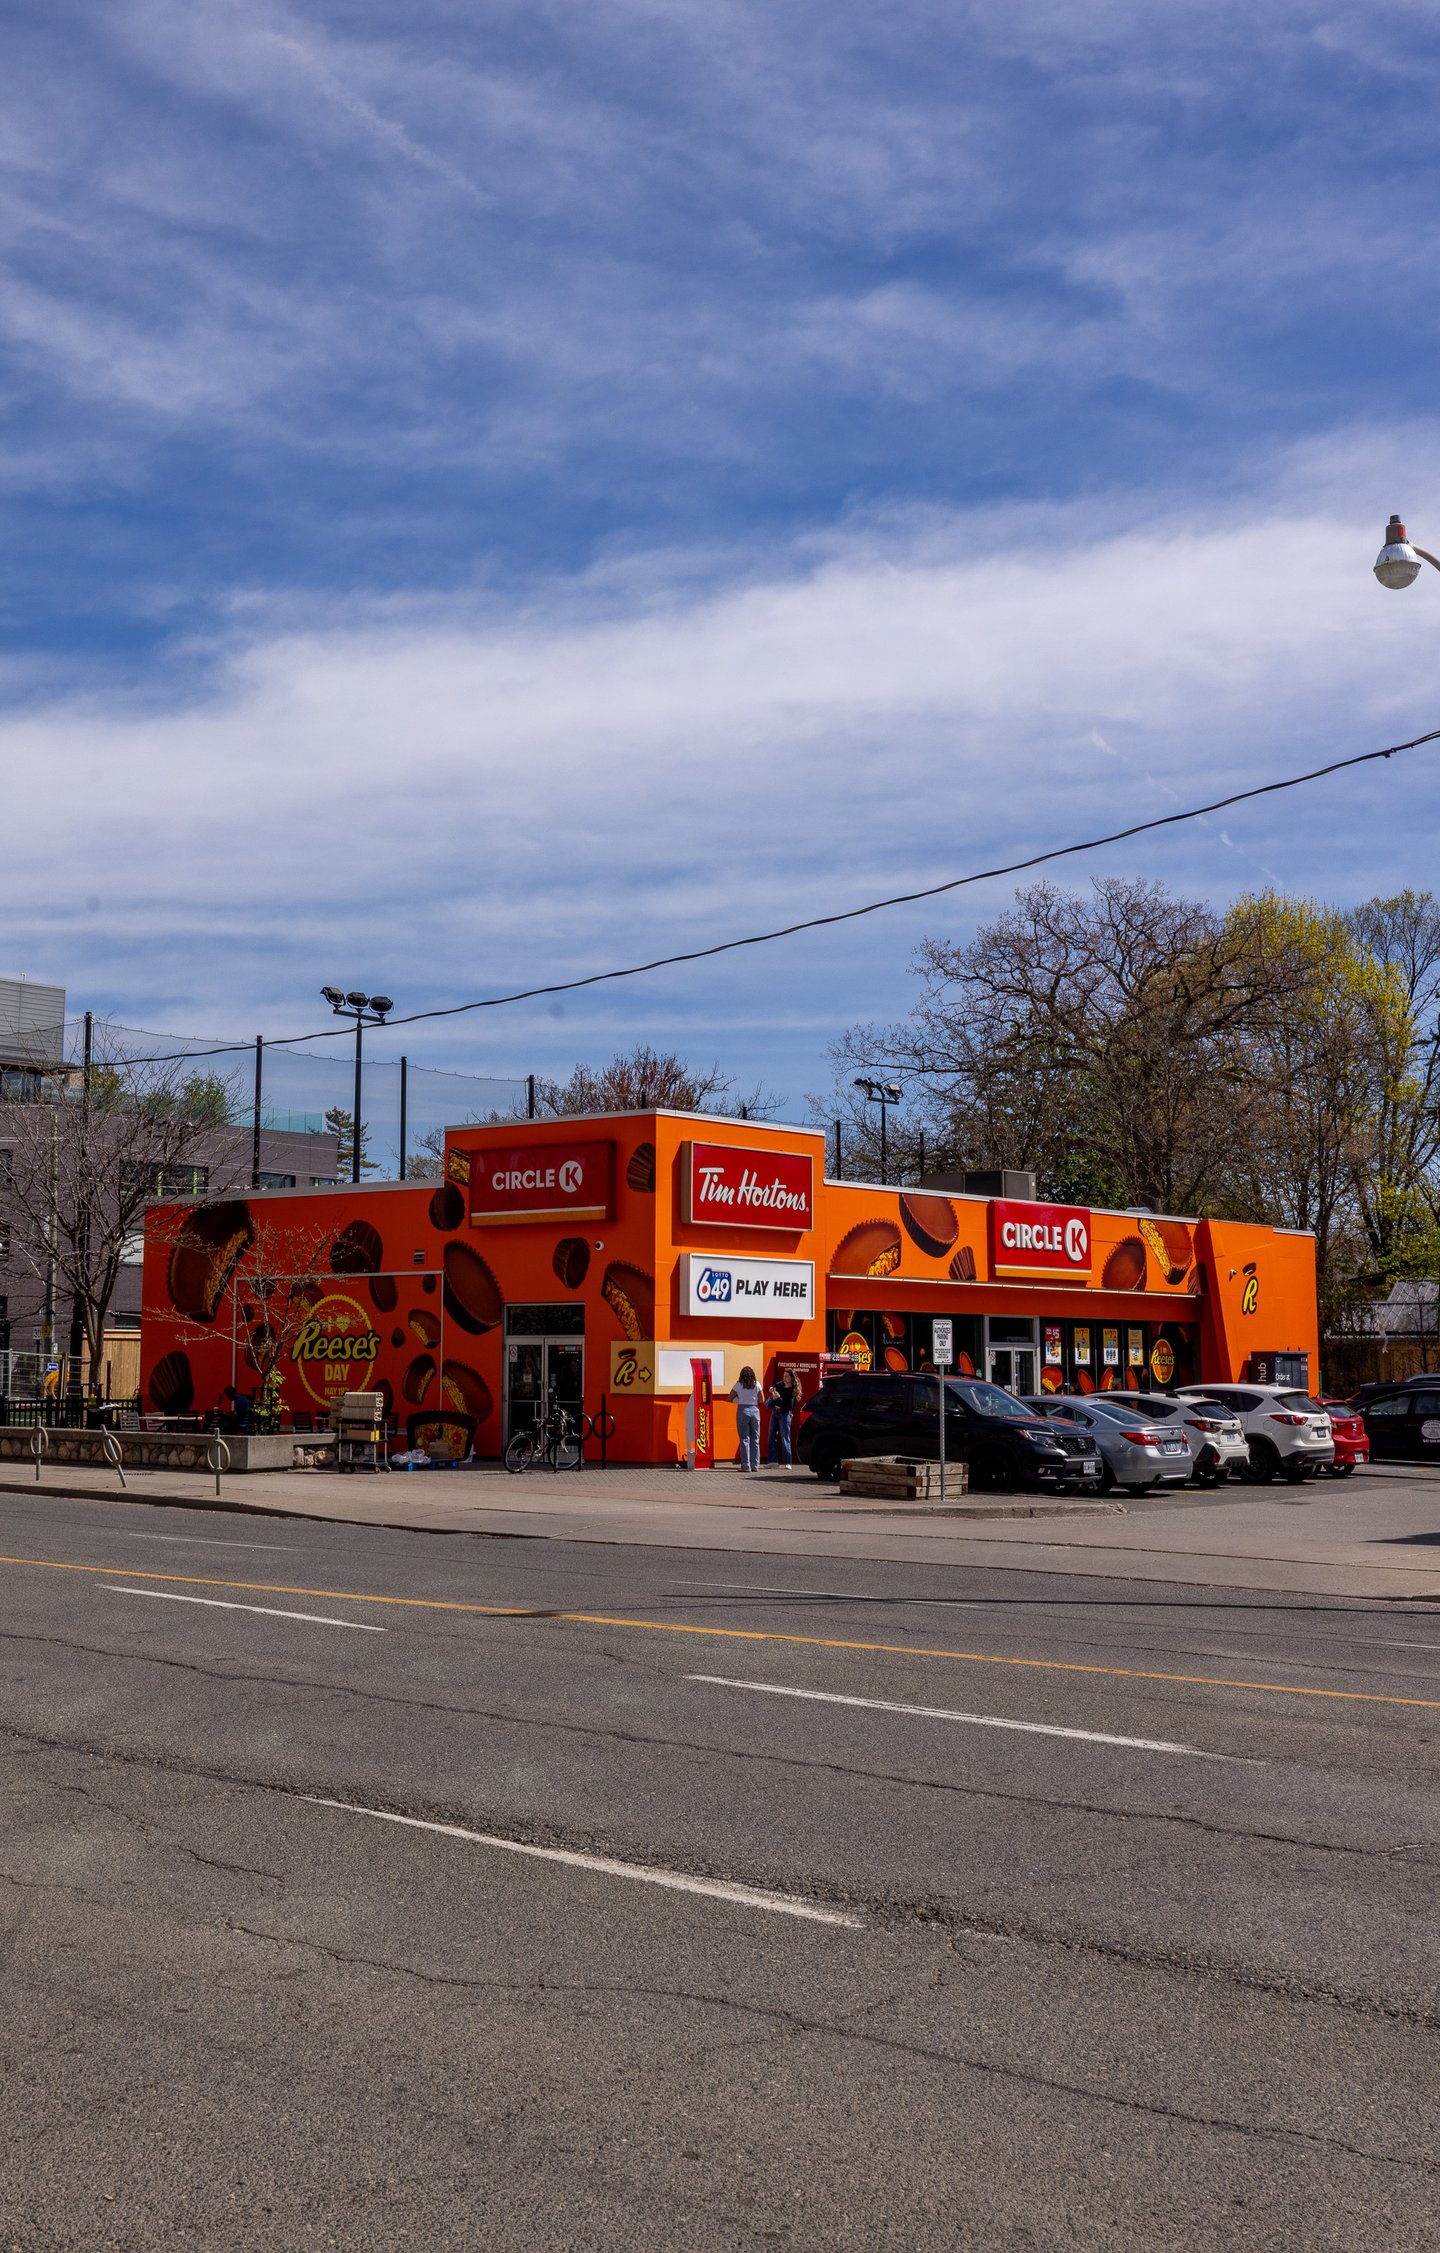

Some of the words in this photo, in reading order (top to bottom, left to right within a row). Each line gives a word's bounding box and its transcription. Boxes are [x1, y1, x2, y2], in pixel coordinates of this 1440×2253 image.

[492, 1169, 555, 1191] CIRCLE
[562, 1163, 582, 1191] K
[699, 1167, 735, 1205] Tim
[737, 1168, 806, 1211] Hortons
[1002, 1222, 1063, 1252] CIRCLE
[1067, 1222, 1087, 1260] K
[736, 1280, 769, 1296] PLAY
[773, 1281, 807, 1298] HERE
[1242, 1277, 1258, 1314] R
[291, 1321, 380, 1360] Reese's
[1150, 1349, 1175, 1366] Reese's
[324, 1364, 350, 1381] DAY
[615, 1359, 637, 1386] R
[1257, 1362, 1268, 1382] hub
[324, 1387, 337, 1396] MAY
[696, 1407, 706, 1454] Reese's
